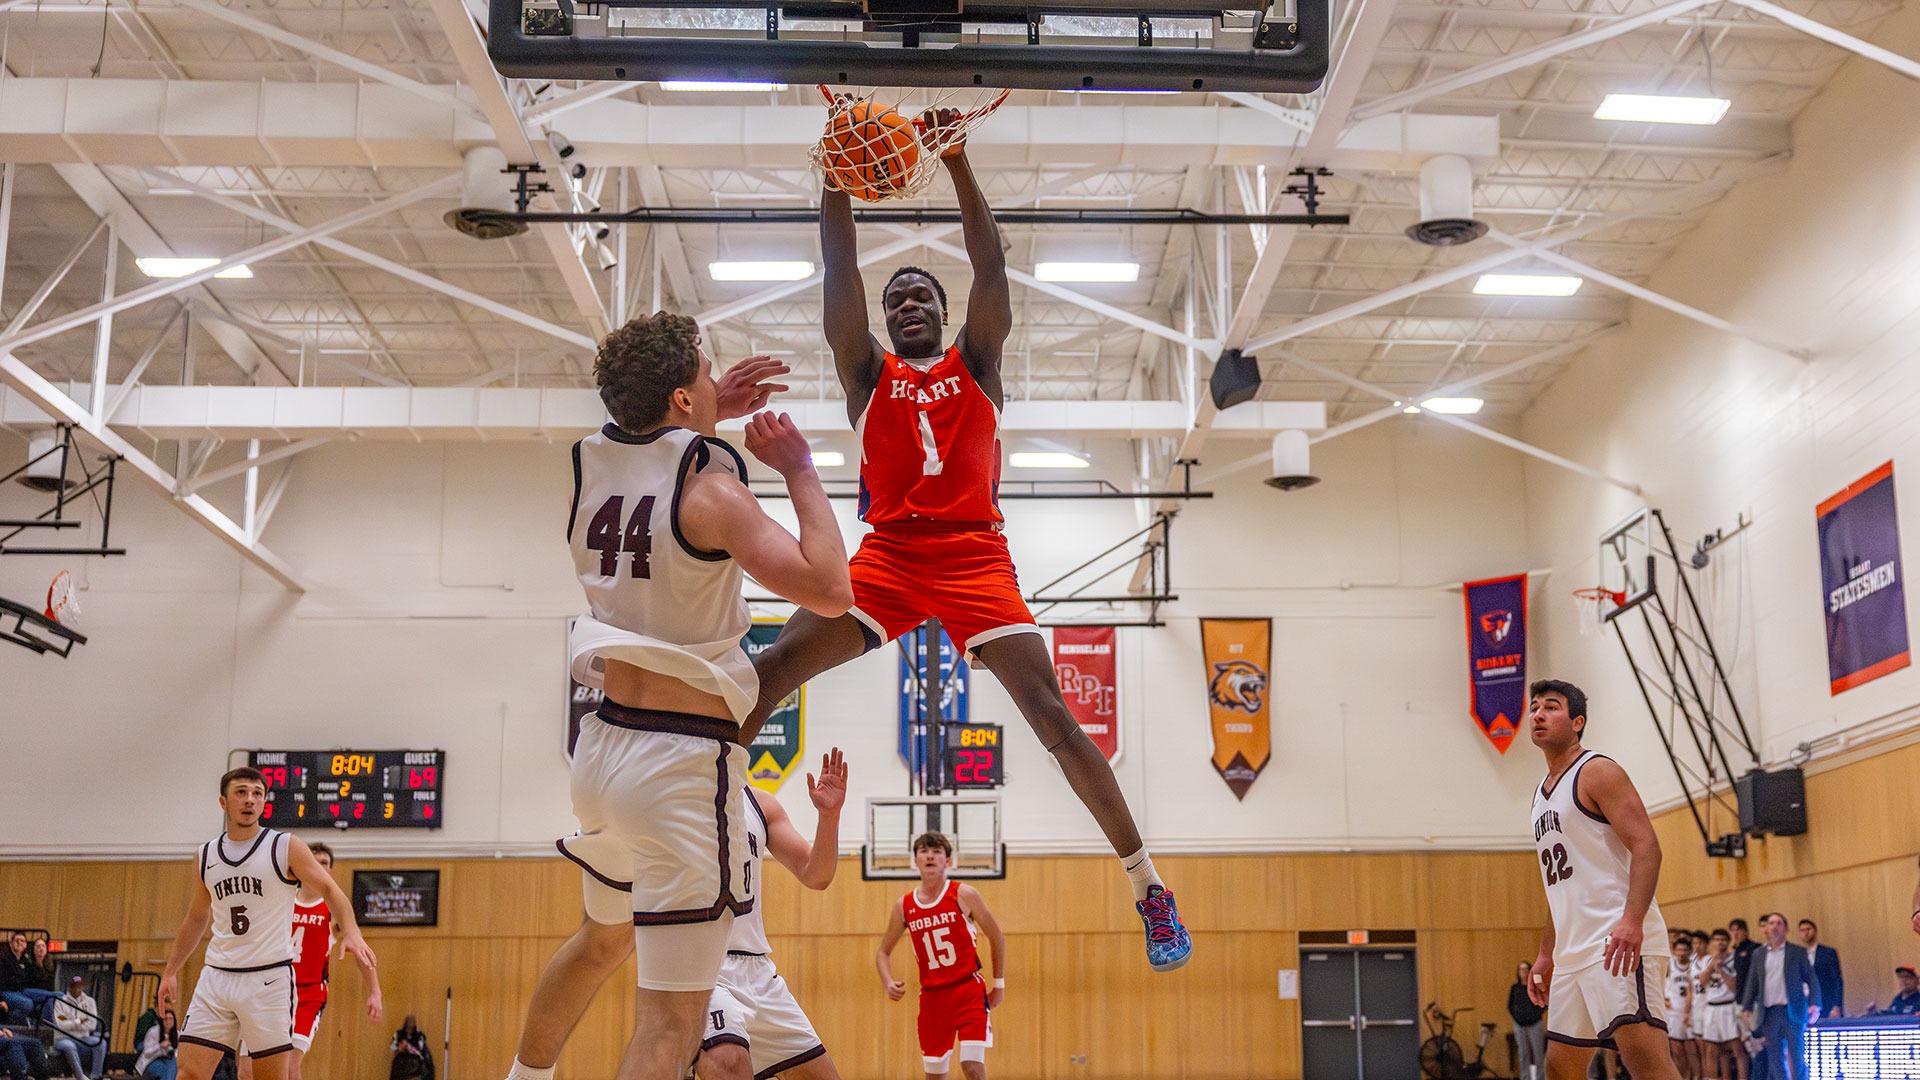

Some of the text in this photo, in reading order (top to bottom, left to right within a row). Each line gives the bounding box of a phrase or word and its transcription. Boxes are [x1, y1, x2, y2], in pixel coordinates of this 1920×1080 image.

[918, 410, 943, 476] 1
[587, 495, 656, 579] 44
[1829, 561, 1895, 613] STATESMEN
[1056, 663, 1114, 715] RPI
[960, 729, 997, 747] 8:04
[257, 752, 287, 765] HOME
[331, 754, 374, 776] 8:04
[404, 752, 437, 765] GUEST
[955, 751, 992, 782] 22
[410, 767, 436, 788] 69
[340, 781, 351, 797] 2
[353, 802, 365, 819] 2
[383, 802, 395, 819] 3
[1534, 809, 1562, 842] UNION
[1541, 843, 1573, 886] 22
[214, 876, 264, 900] UNION
[230, 905, 250, 936] 5
[292, 913, 325, 926] BART
[909, 911, 957, 932] HOBART
[922, 927, 957, 970] 15
[710, 1009, 725, 1030] U
